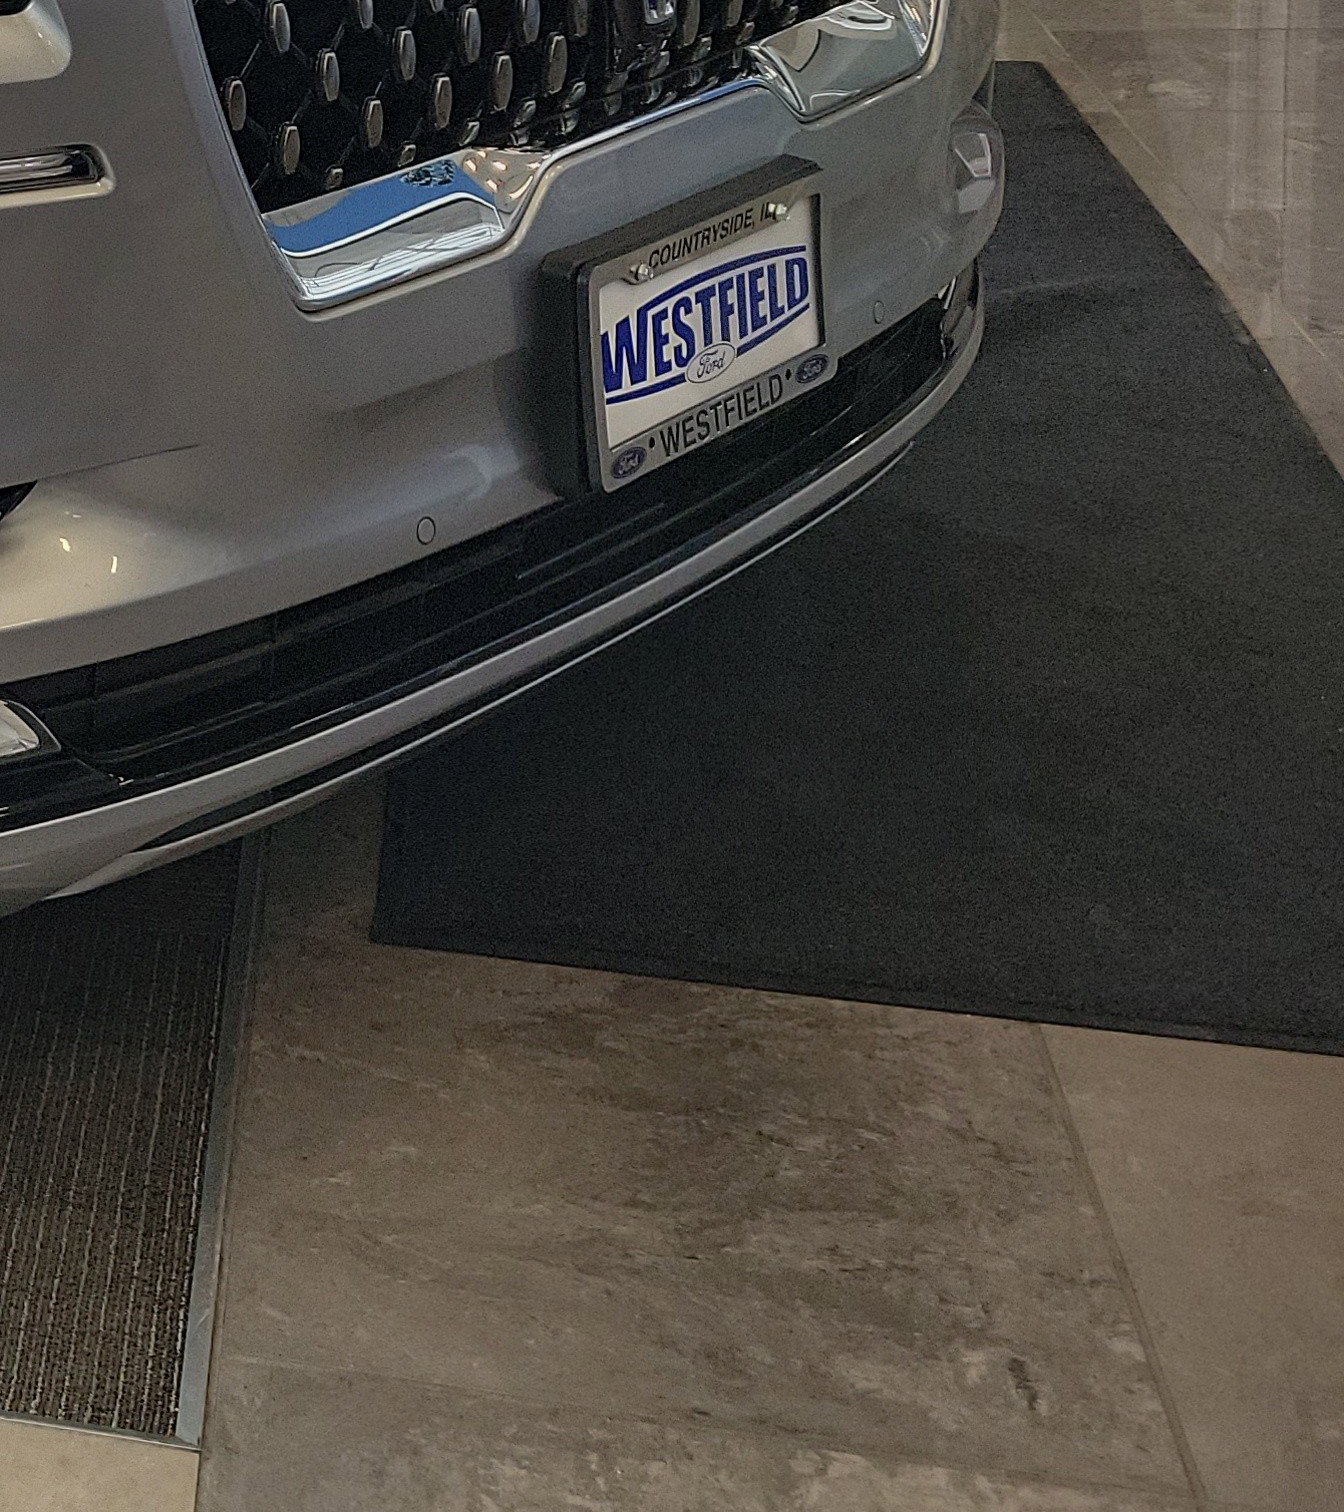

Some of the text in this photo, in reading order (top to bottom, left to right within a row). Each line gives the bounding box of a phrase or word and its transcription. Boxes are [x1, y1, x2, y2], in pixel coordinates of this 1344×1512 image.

[601, 257, 809, 393] WESTFIELD
[696, 349, 726, 378] Ford
[659, 374, 783, 458] WESTFIELD
